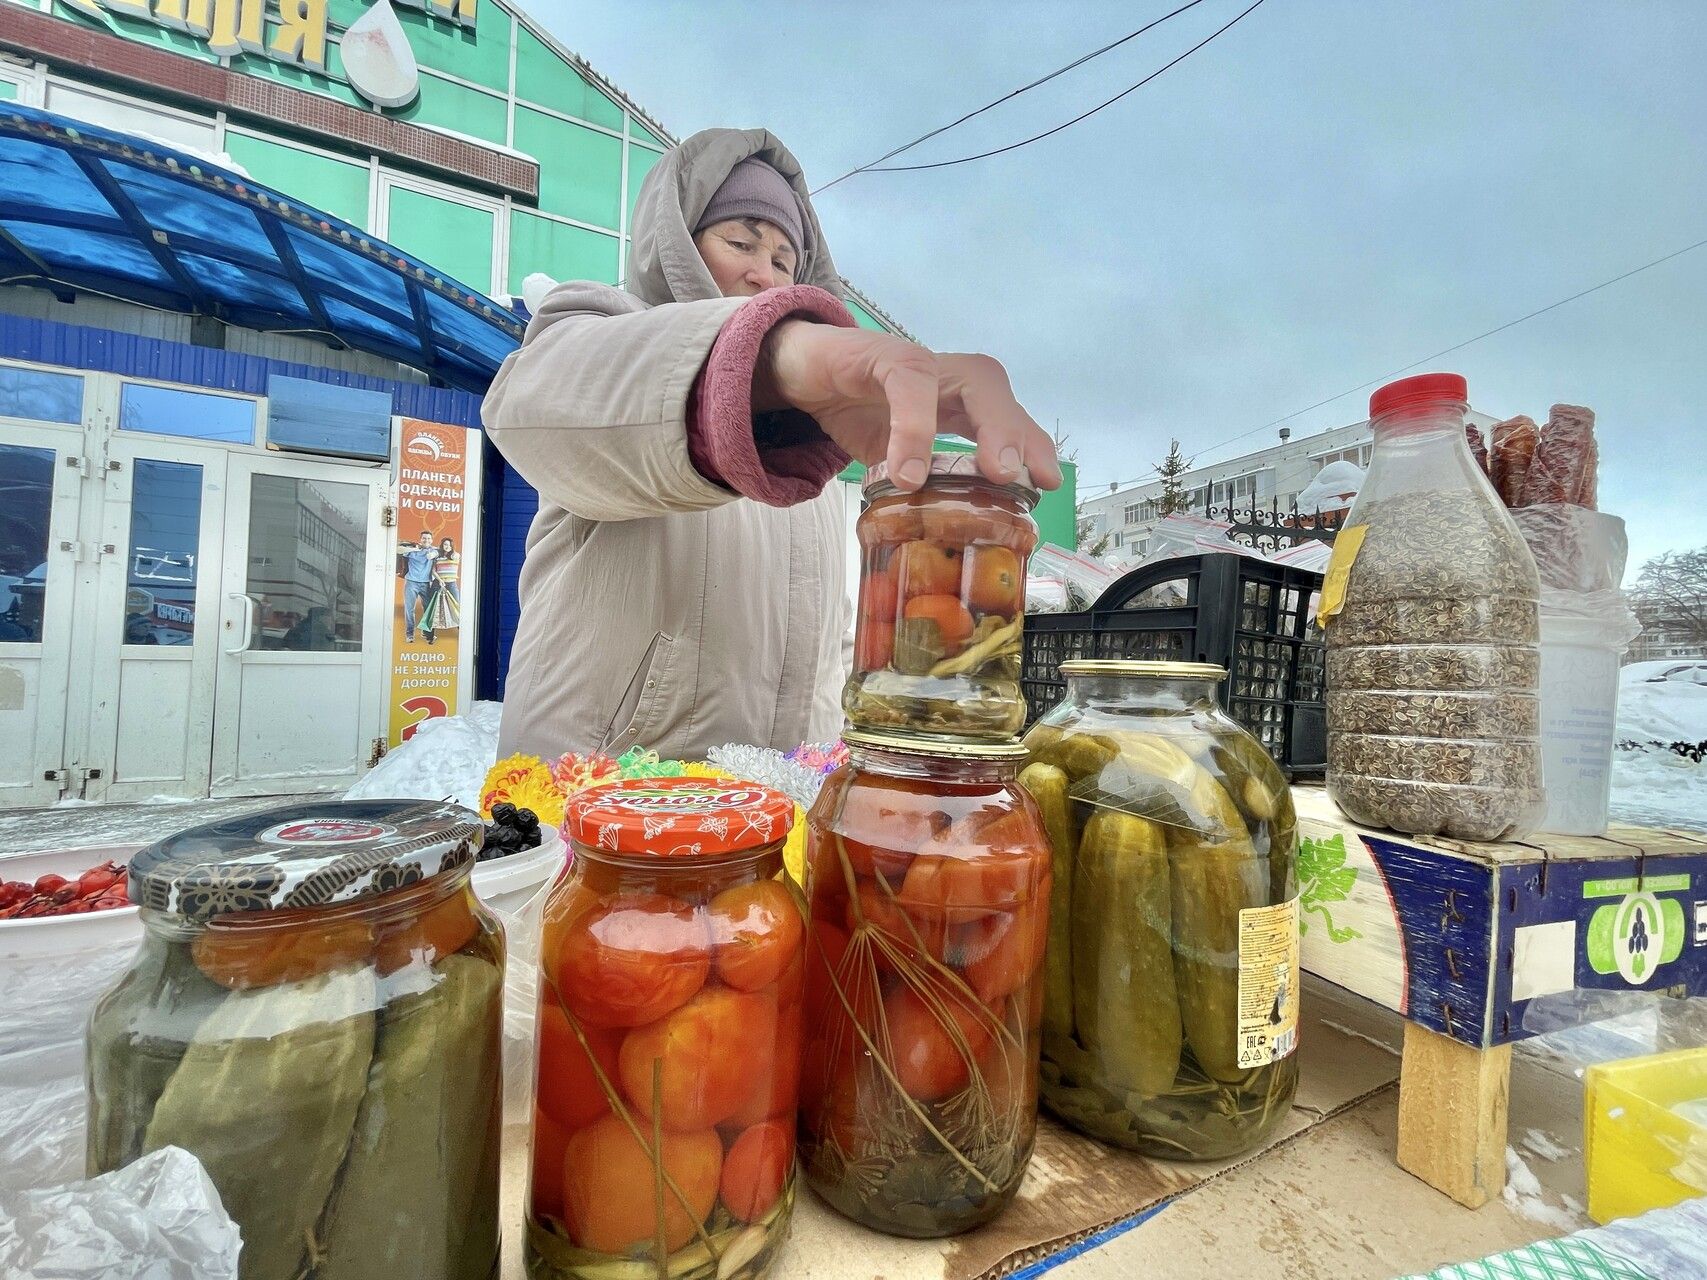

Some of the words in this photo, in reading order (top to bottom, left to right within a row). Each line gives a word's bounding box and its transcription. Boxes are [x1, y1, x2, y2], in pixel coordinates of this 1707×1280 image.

[417, 432, 445, 449] ПЛАНЕТА
[440, 451, 461, 459] ОБУВИ
[402, 468, 462, 484] ПЛАНЕТА
[400, 483, 464, 499] ОДЕЖДЫ
[402, 498, 412, 508] И
[415, 499, 460, 512] ОБУВИ
[400, 652, 446, 663] МОДНО
[394, 666, 409, 675] НЕ
[412, 665, 458, 675] ЗНАЧИТ
[401, 679, 450, 689] ДОРОГО
